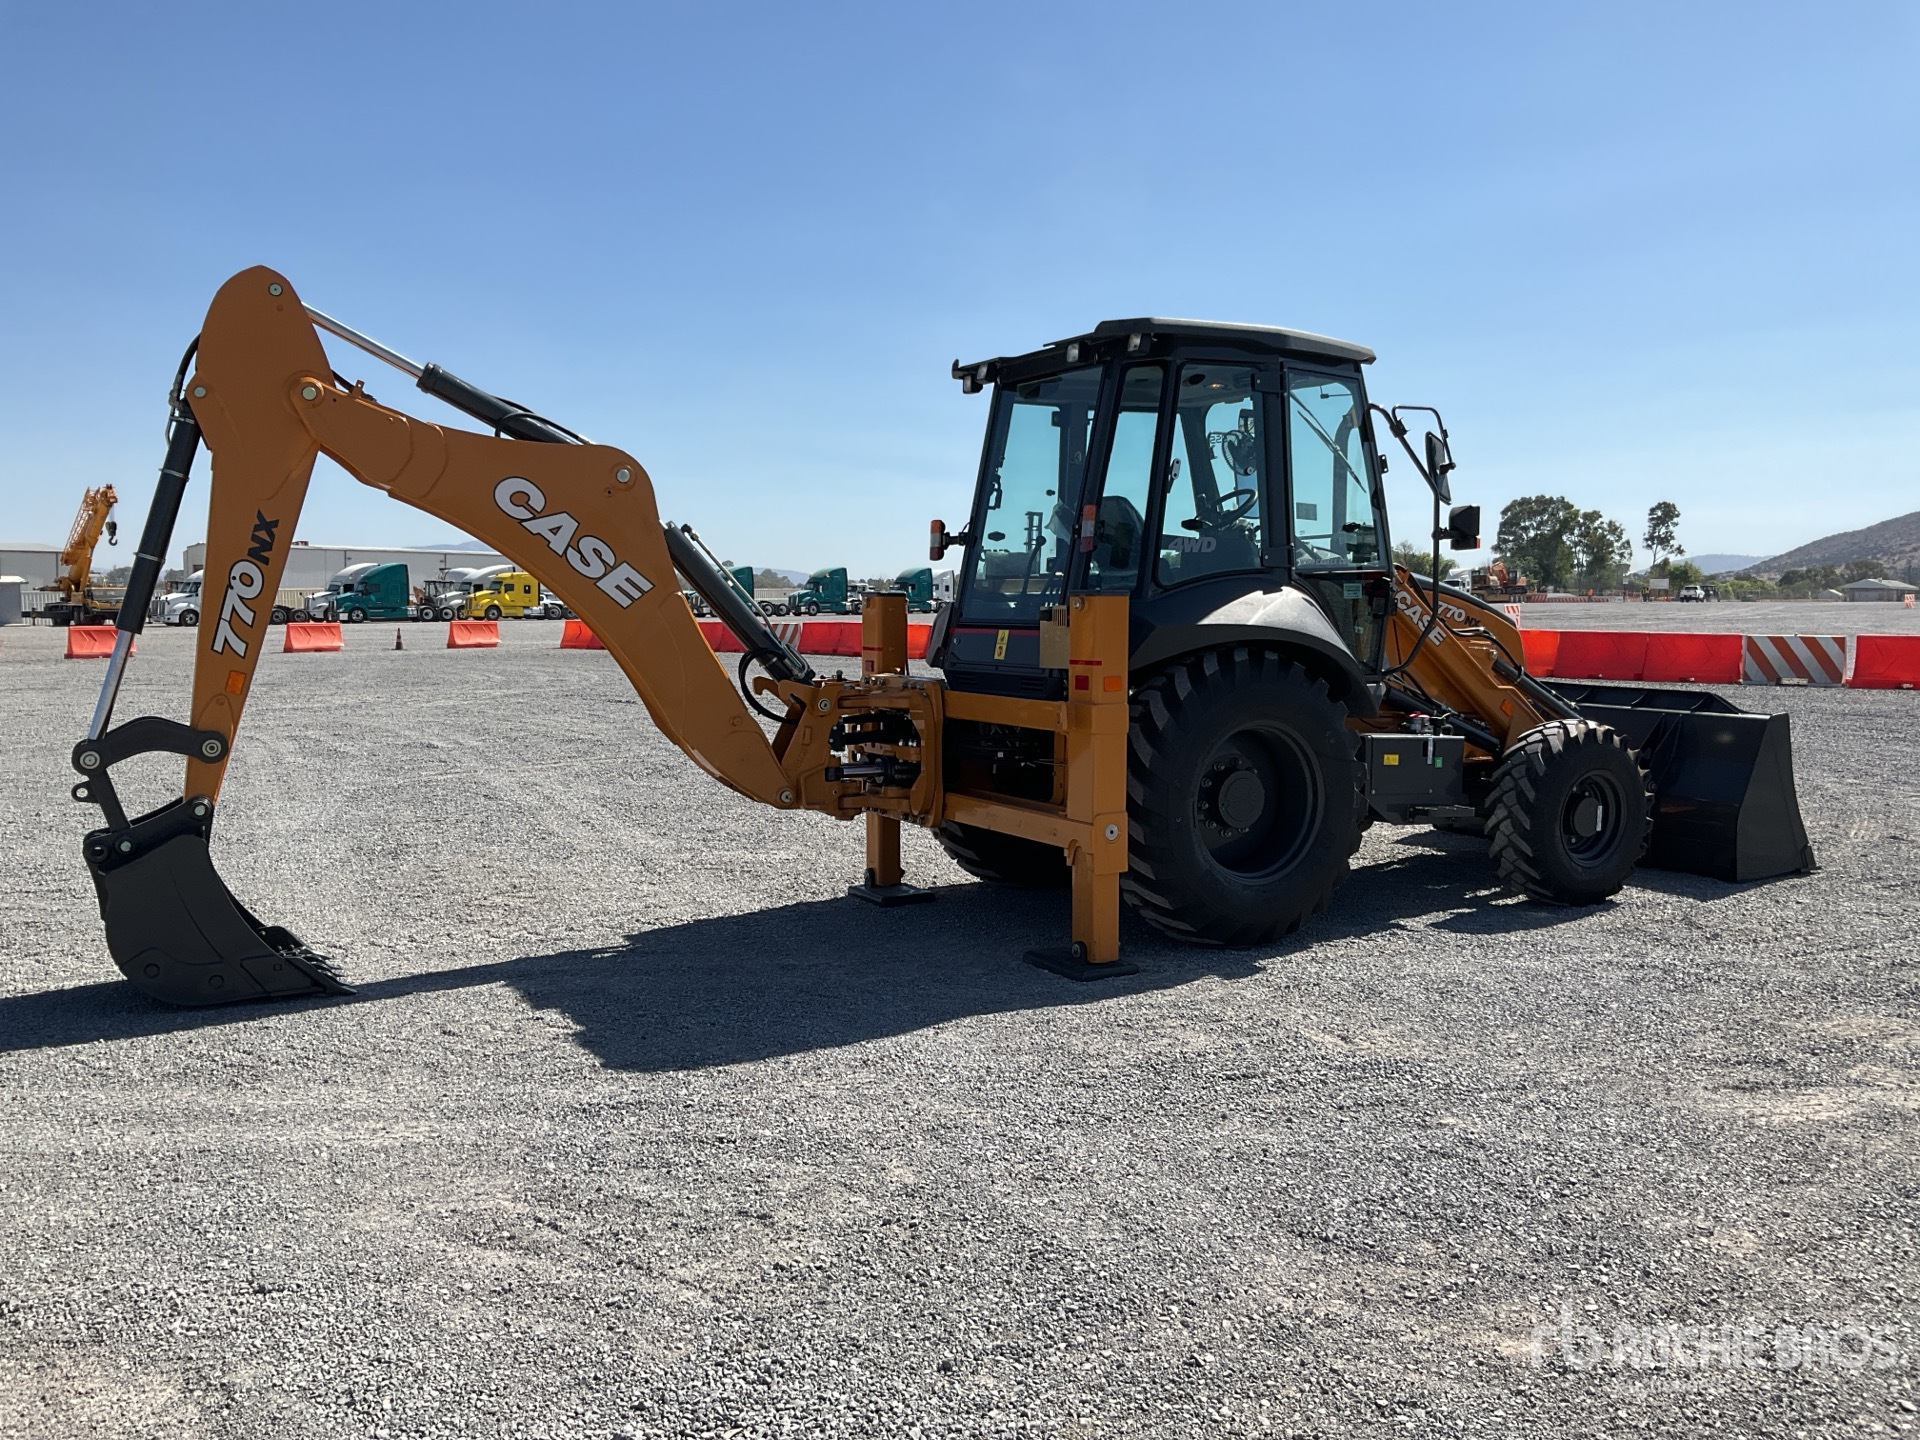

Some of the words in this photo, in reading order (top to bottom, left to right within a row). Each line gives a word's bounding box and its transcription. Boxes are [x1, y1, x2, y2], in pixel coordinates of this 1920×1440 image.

[493, 475, 656, 610] CASE
[1168, 535, 1217, 553] 4WD
[1394, 590, 1447, 647] CASE
